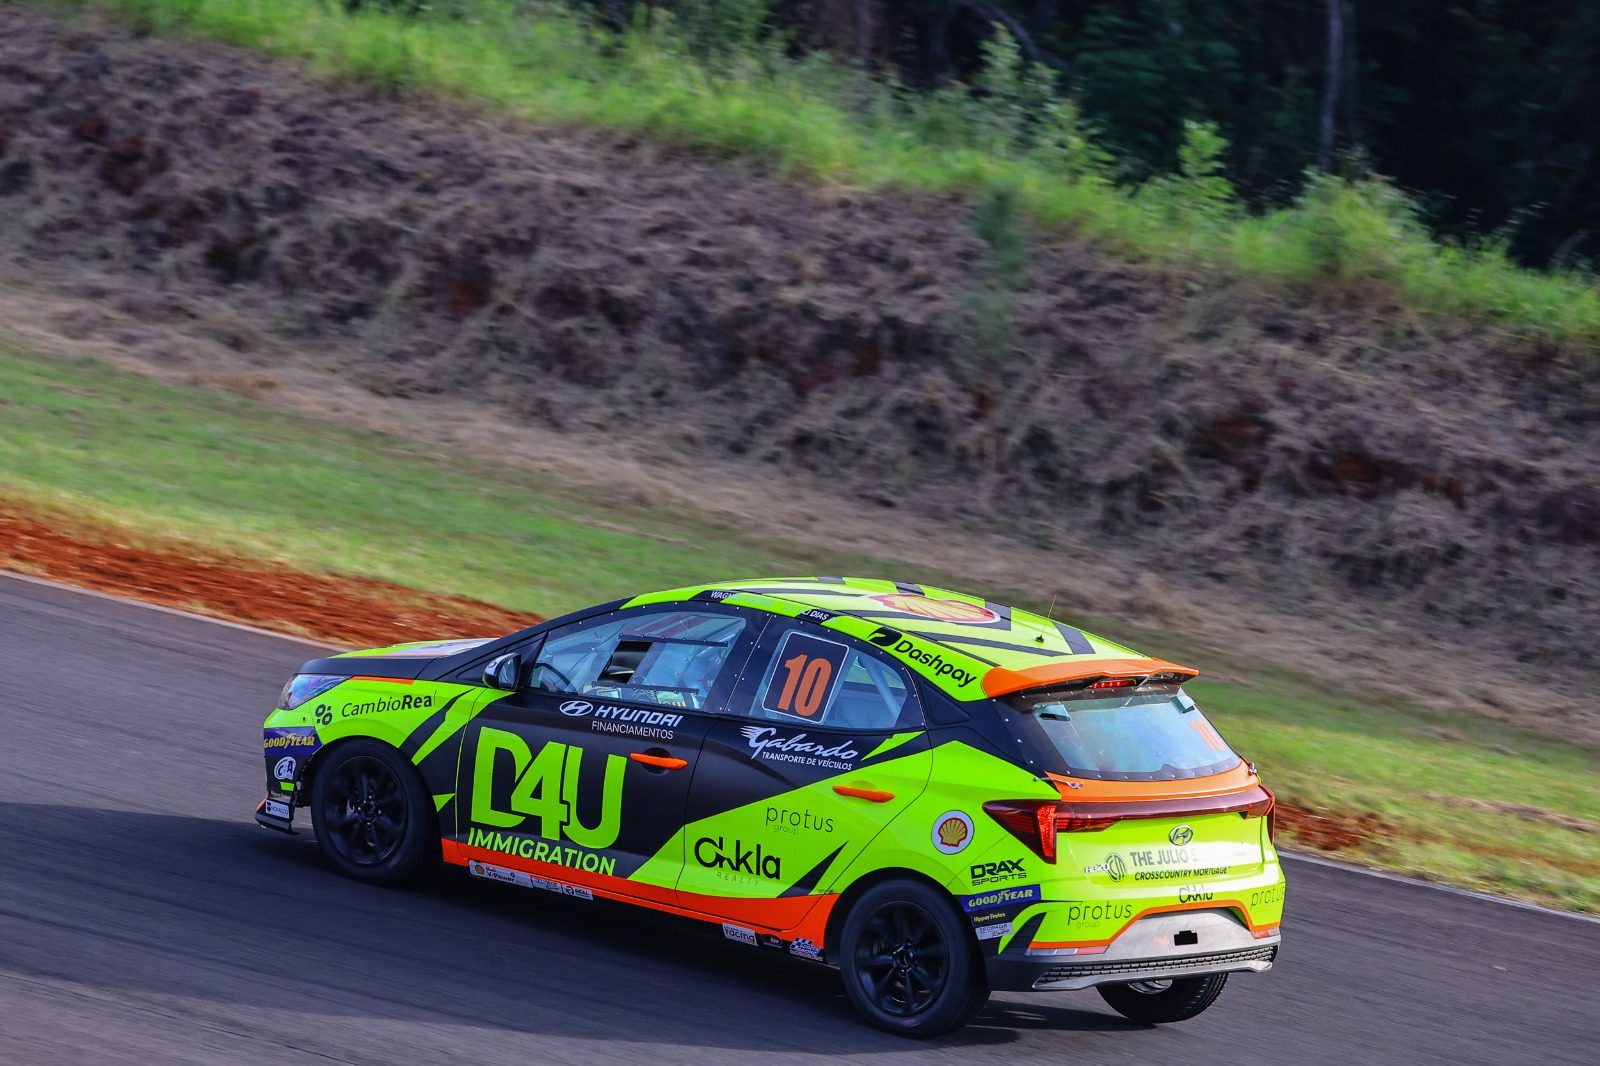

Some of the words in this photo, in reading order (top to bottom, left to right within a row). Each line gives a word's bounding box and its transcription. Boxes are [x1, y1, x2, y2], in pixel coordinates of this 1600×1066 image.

[809, 609, 829, 621] DIAS
[894, 639, 978, 688] Dashpay
[777, 653, 832, 717] 10
[594, 705, 683, 728] HYUNDAI
[591, 721, 674, 740] FINANCIAMENTOS
[263, 733, 315, 749] GOODYEAR
[741, 726, 859, 760] Gabardo
[762, 751, 805, 764] TRANSPORTE
[806, 757, 816, 766] DE
[817, 758, 853, 771] VEÍCULOS
[470, 726, 628, 849] D4U
[765, 806, 834, 833] protus
[773, 824, 799, 835] group
[467, 827, 616, 876] IMMIGRATION
[1130, 851, 1153, 867] THE
[1156, 849, 1189, 865] JULIO
[970, 858, 1026, 879] DRAX
[1134, 869, 1193, 881] CROSSCOUNTRY
[716, 871, 760, 886] REALTY
[971, 872, 1027, 886] SPORTS
[968, 889, 1034, 908] GOODYEAR
[1067, 901, 1132, 926] protus
[1076, 920, 1100, 931] group
[724, 928, 755, 944] racing
